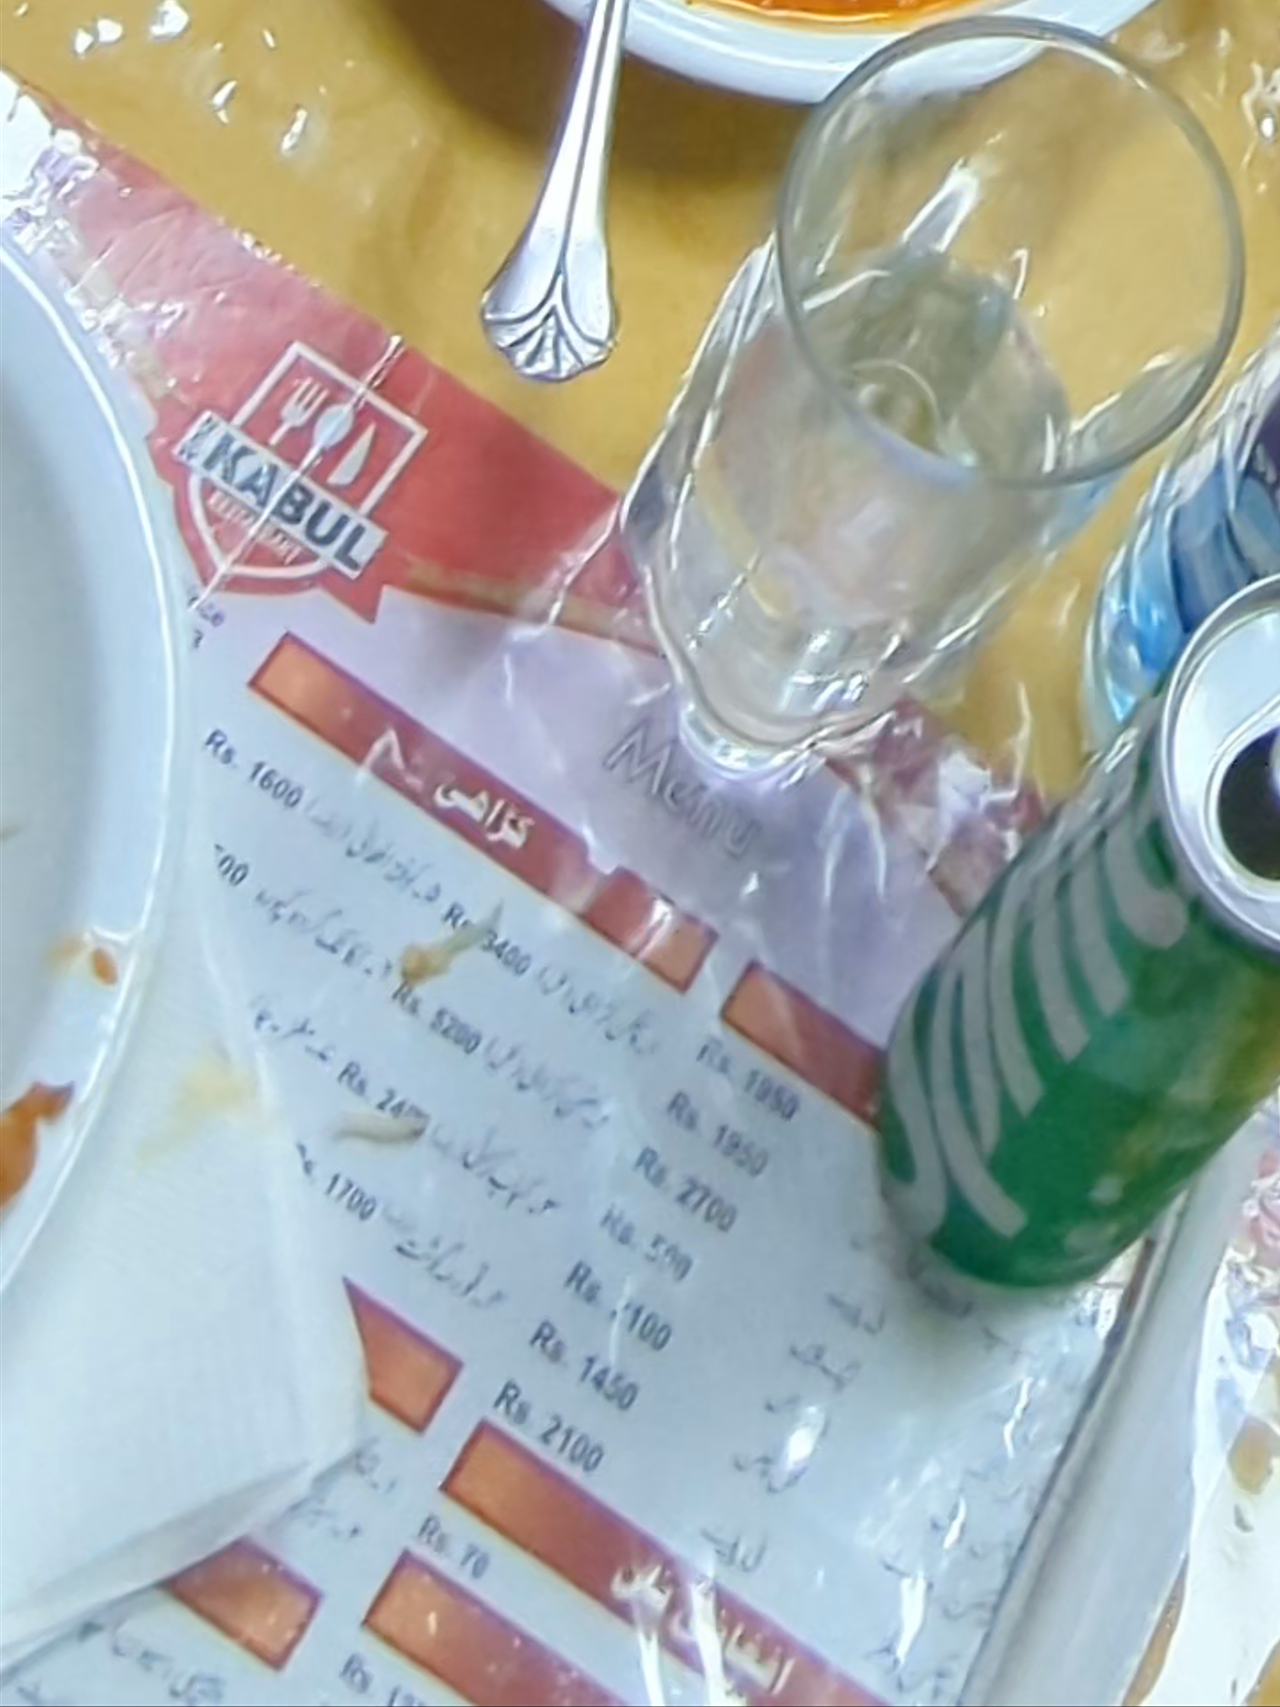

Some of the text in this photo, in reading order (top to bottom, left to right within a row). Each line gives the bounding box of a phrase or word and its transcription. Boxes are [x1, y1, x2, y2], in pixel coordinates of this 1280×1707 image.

[203, 433, 366, 572] KABUL
[249, 761, 304, 809] 1600
[713, 1124, 770, 1178] 1950
[324, 1172, 378, 1222] 1700
[675, 1177, 739, 1233] 2700
[579, 1354, 639, 1412] 1450
[540, 1414, 605, 1473] 2100
[457, 1541, 490, 1580] 70
